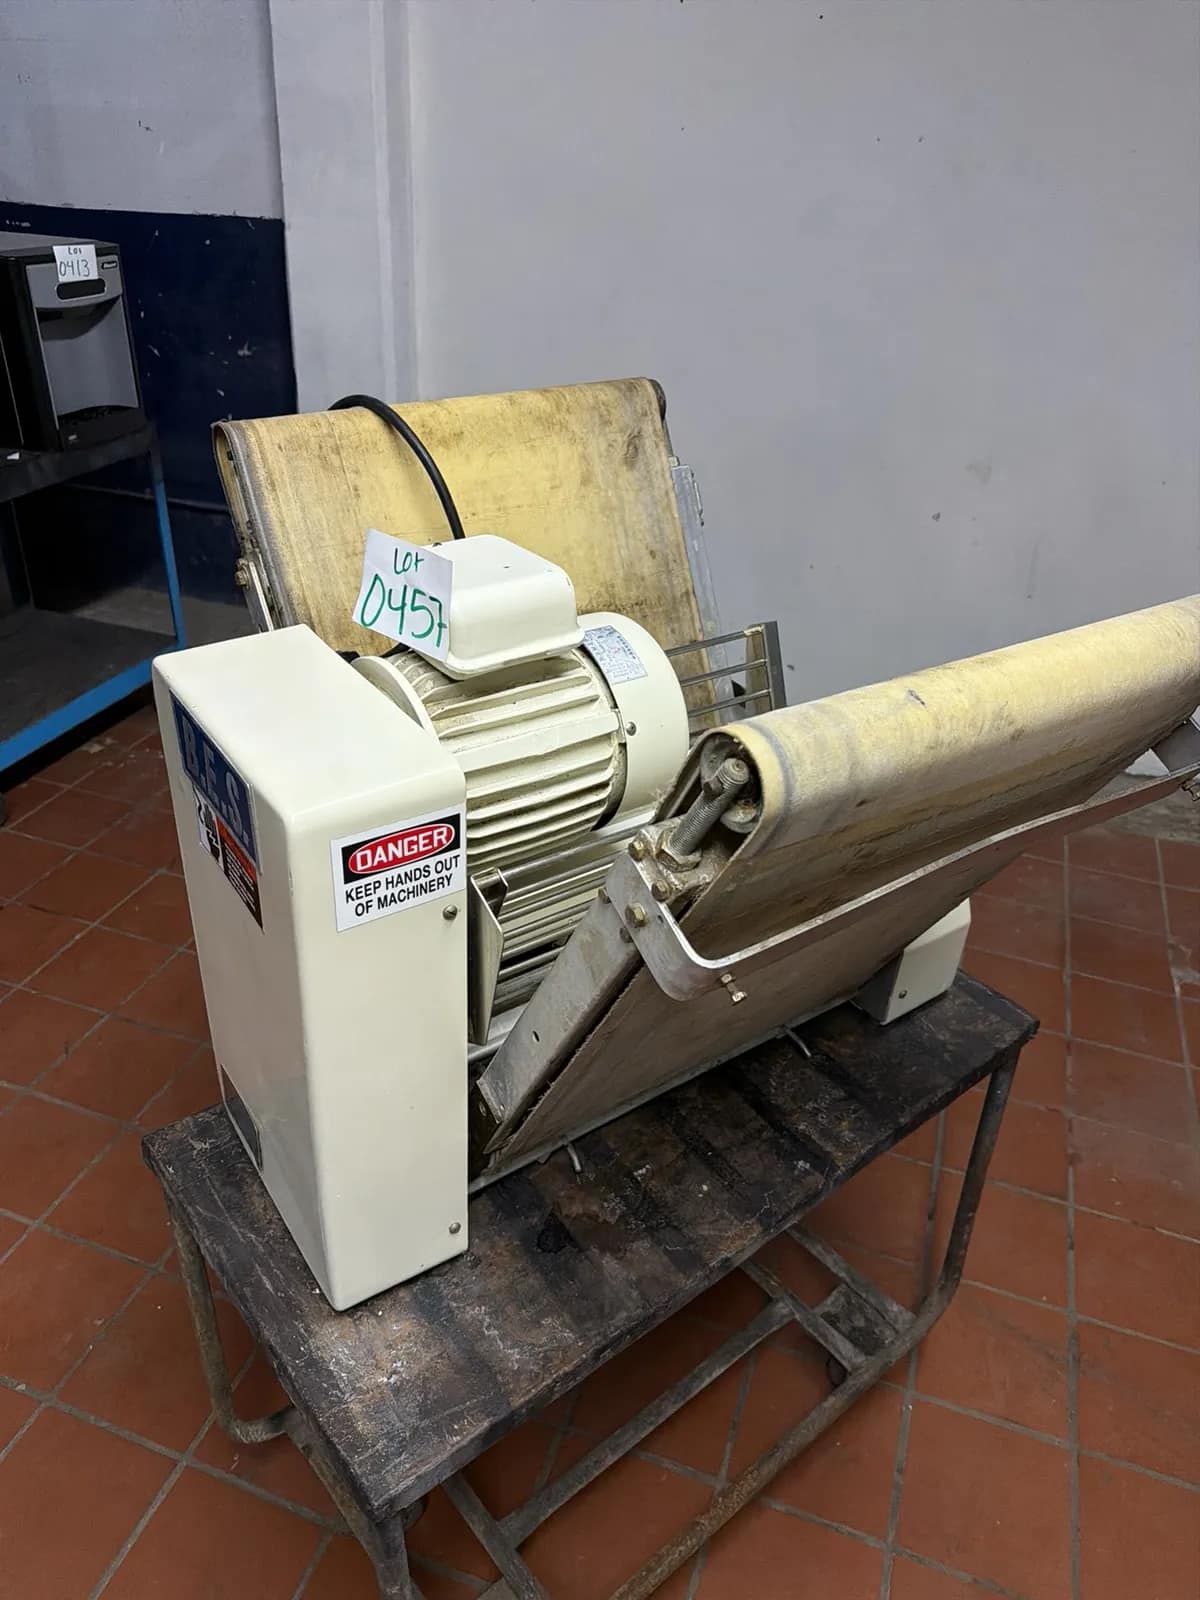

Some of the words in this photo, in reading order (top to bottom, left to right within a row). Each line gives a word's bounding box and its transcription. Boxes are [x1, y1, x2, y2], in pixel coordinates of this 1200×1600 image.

[59, 259, 90, 277] 0413
[360, 573, 448, 648] 0457
[355, 826, 449, 872] DANGER
[345, 879, 382, 904] KEEP
[385, 864, 431, 891] HANDS
[434, 854, 461, 875] OUT
[354, 899, 373, 917] OF
[377, 873, 453, 910] MACHINERY
